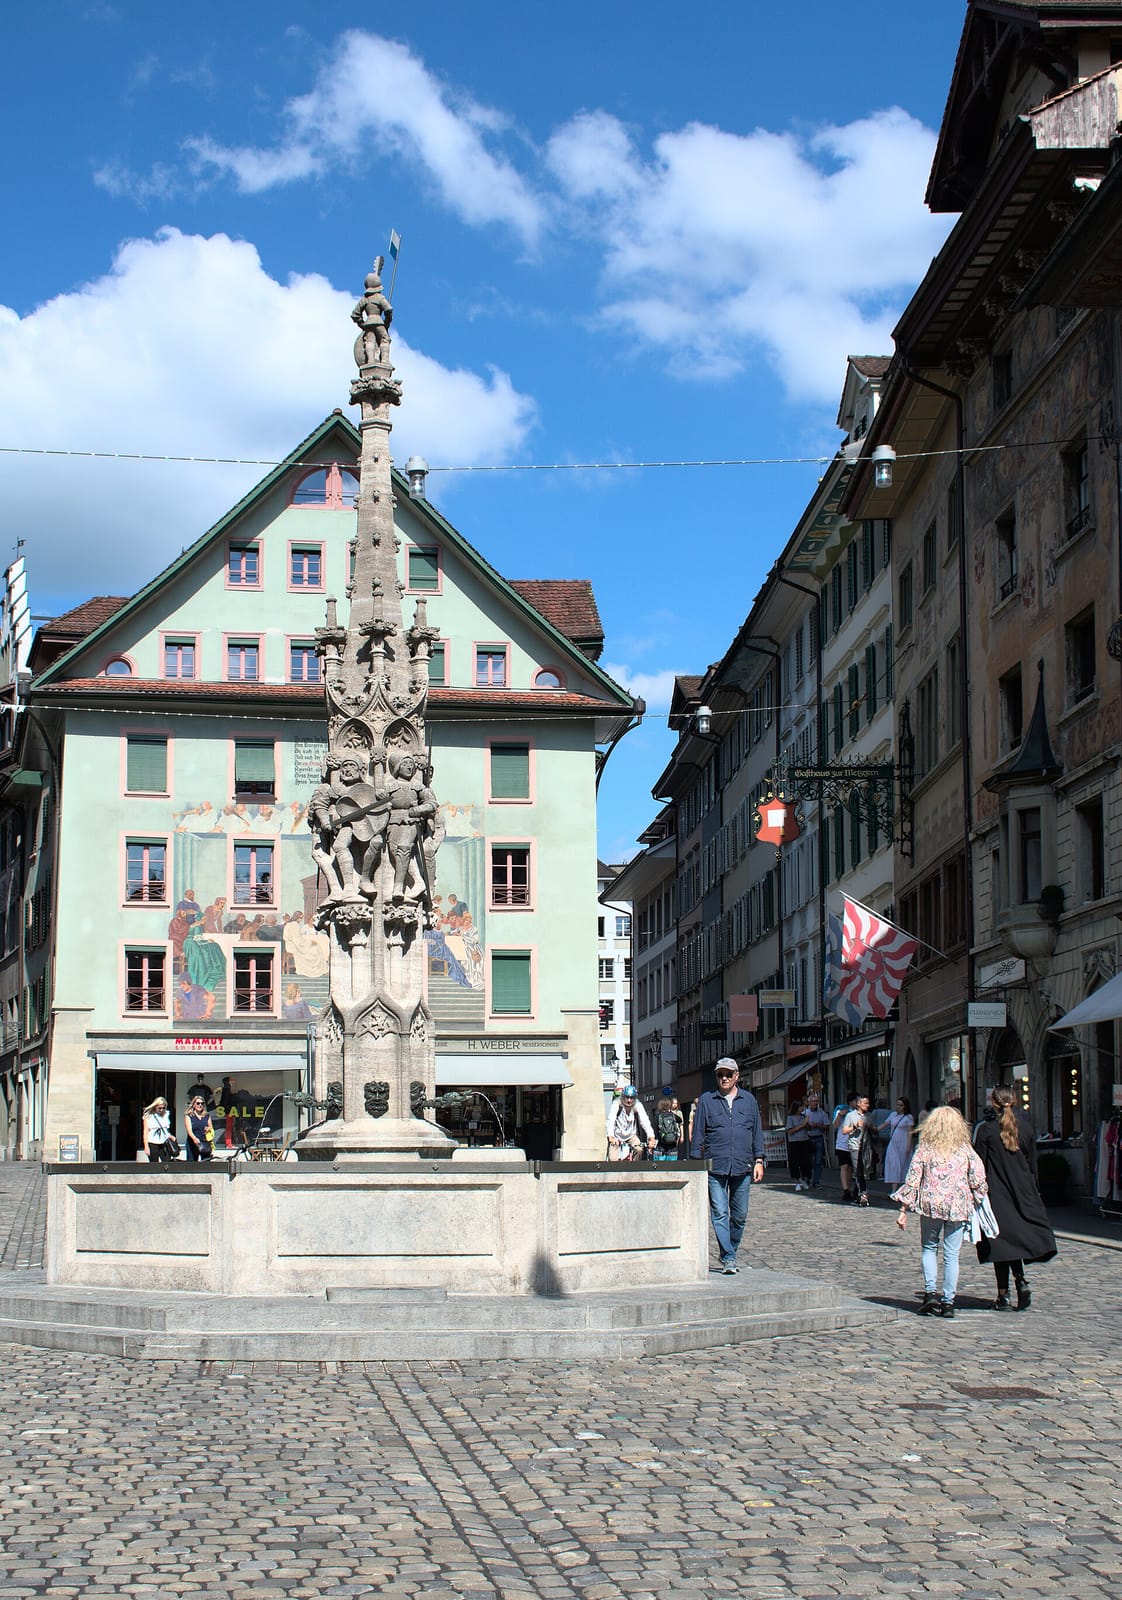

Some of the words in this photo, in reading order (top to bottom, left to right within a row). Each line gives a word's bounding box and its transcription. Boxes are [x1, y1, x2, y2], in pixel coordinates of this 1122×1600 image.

[831, 770, 842, 778] zur
[175, 1037, 223, 1045] MAMMUT
[791, 1035, 822, 1043] sandro
[468, 1040, 478, 1050] H.
[480, 1040, 520, 1050] WEBER
[215, 1106, 265, 1118] SALE
